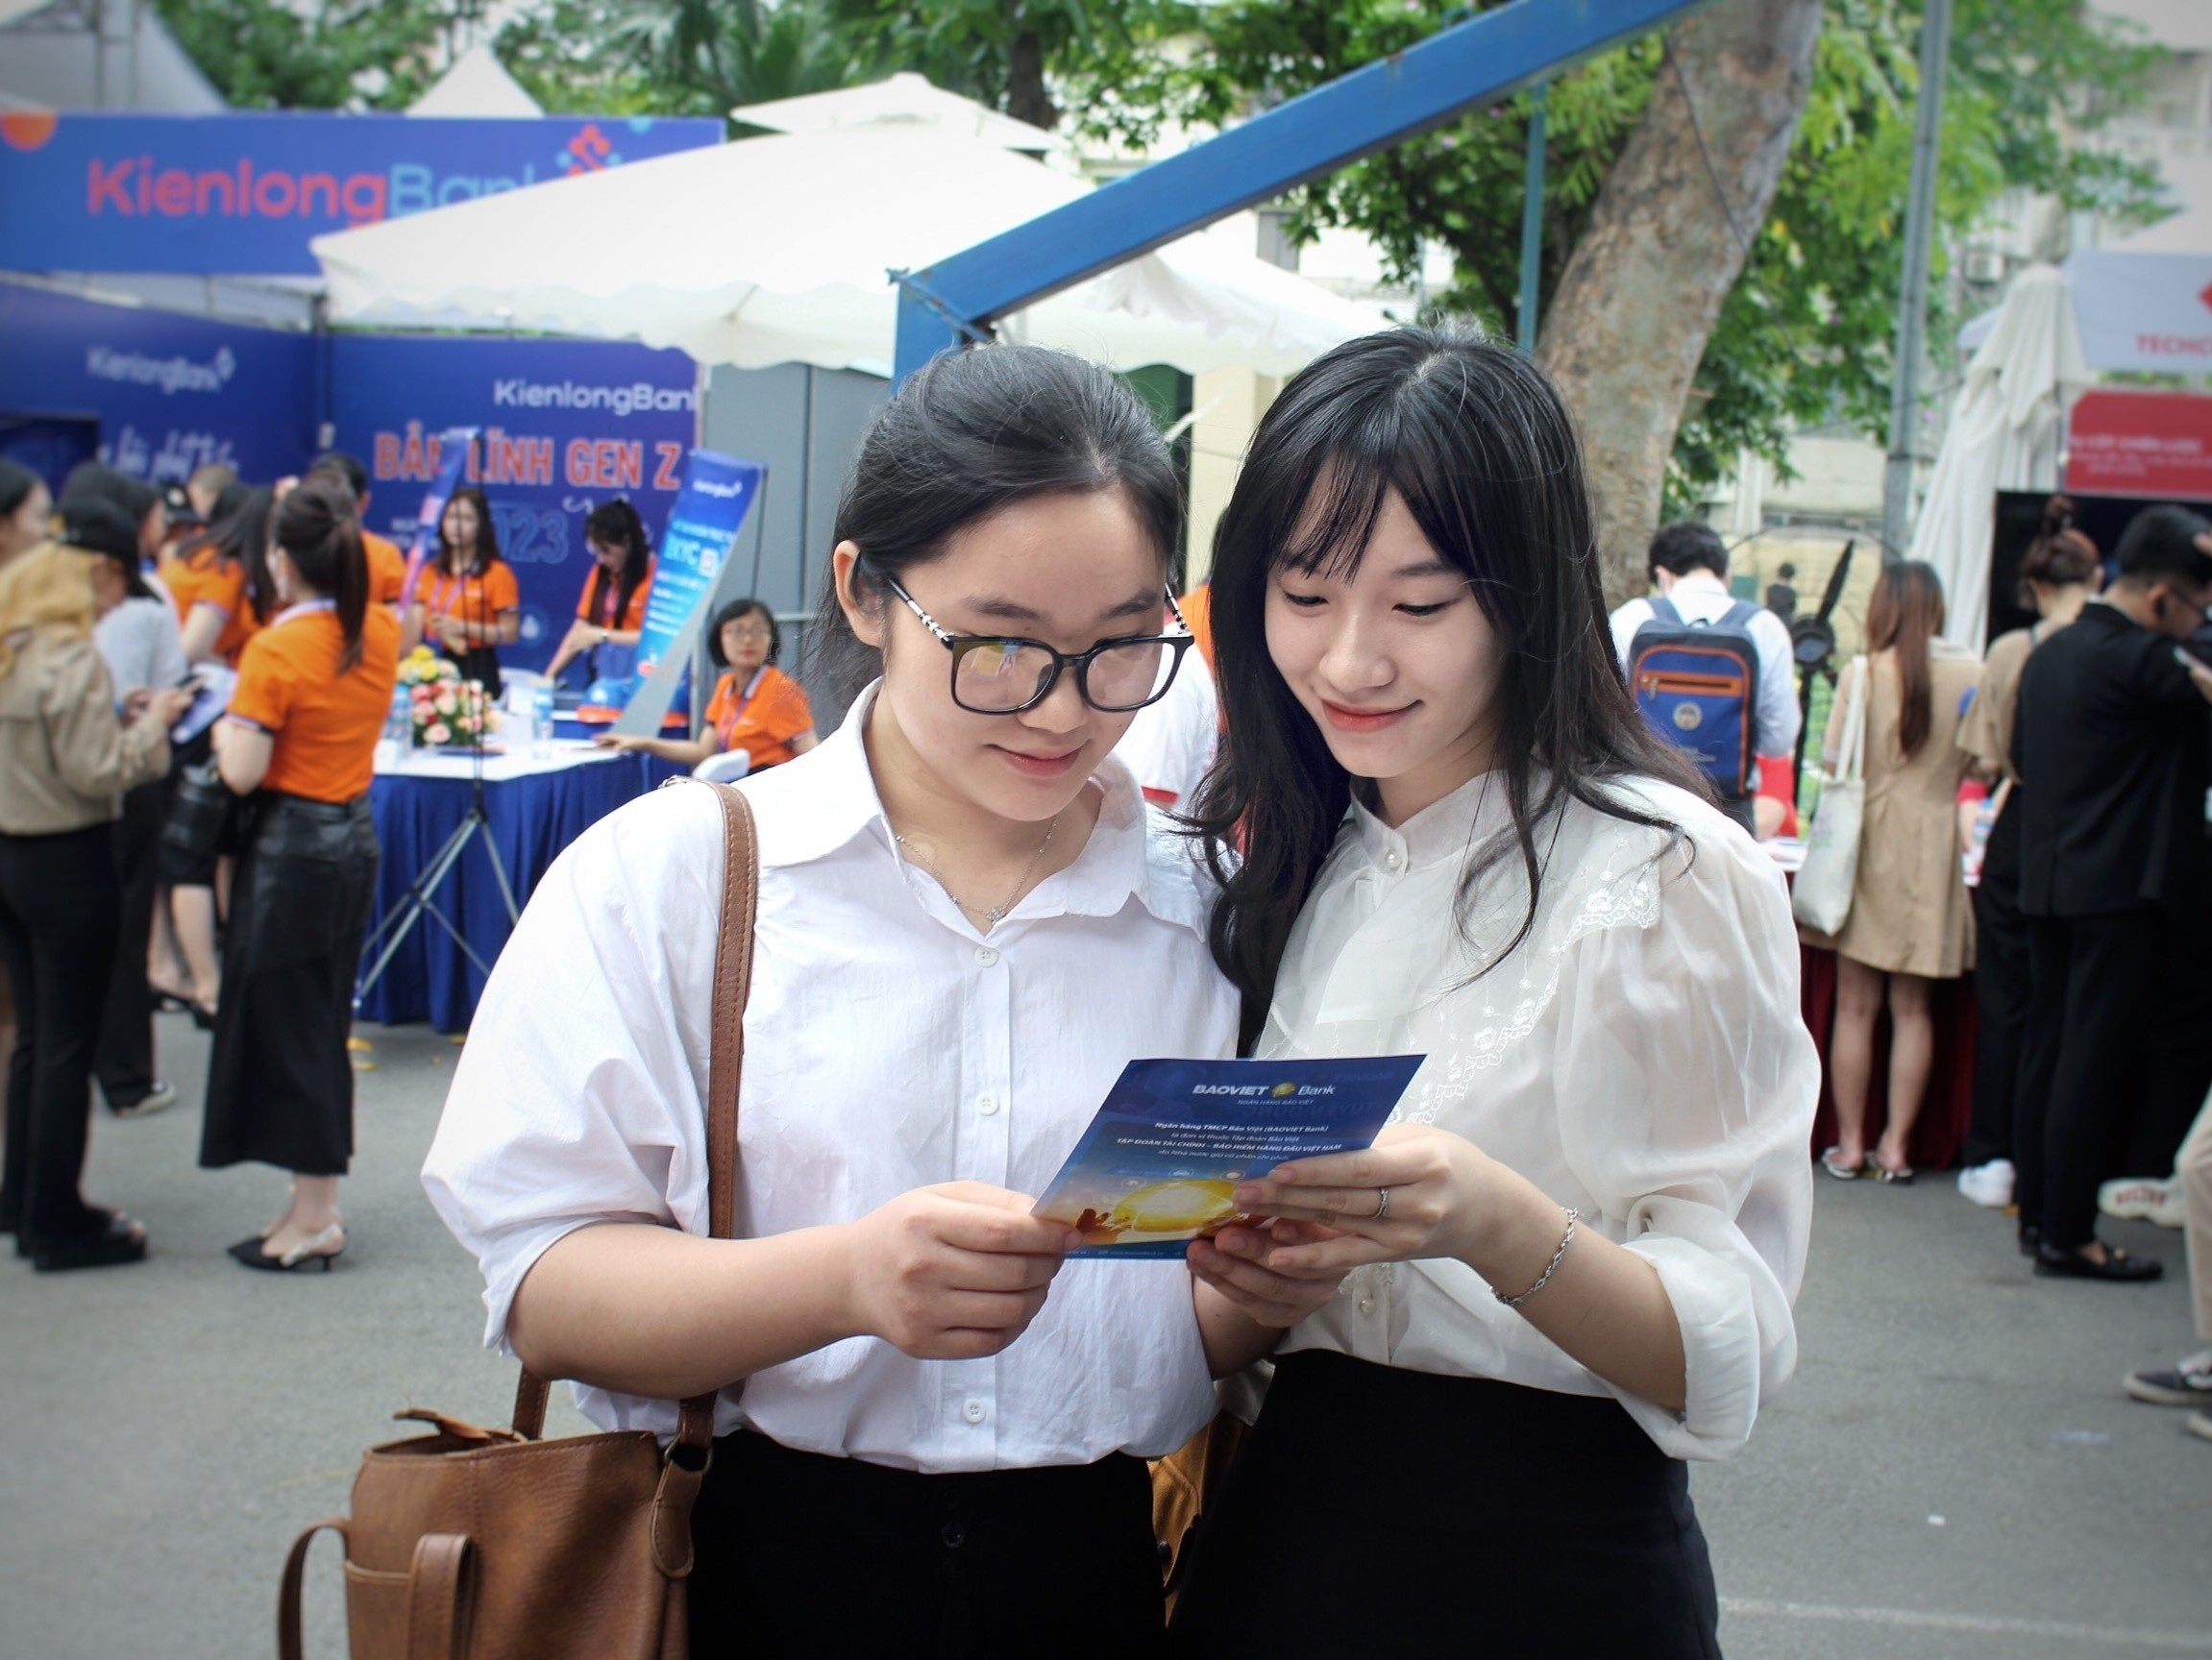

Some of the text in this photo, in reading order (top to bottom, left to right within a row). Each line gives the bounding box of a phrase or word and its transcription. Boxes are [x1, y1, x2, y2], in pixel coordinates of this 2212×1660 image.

[494, 380, 696, 416] KienlongBan
[566, 434, 642, 489] GEN
[652, 441, 683, 490] Z
[1192, 1085, 1336, 1096] BAOVIET Bank
